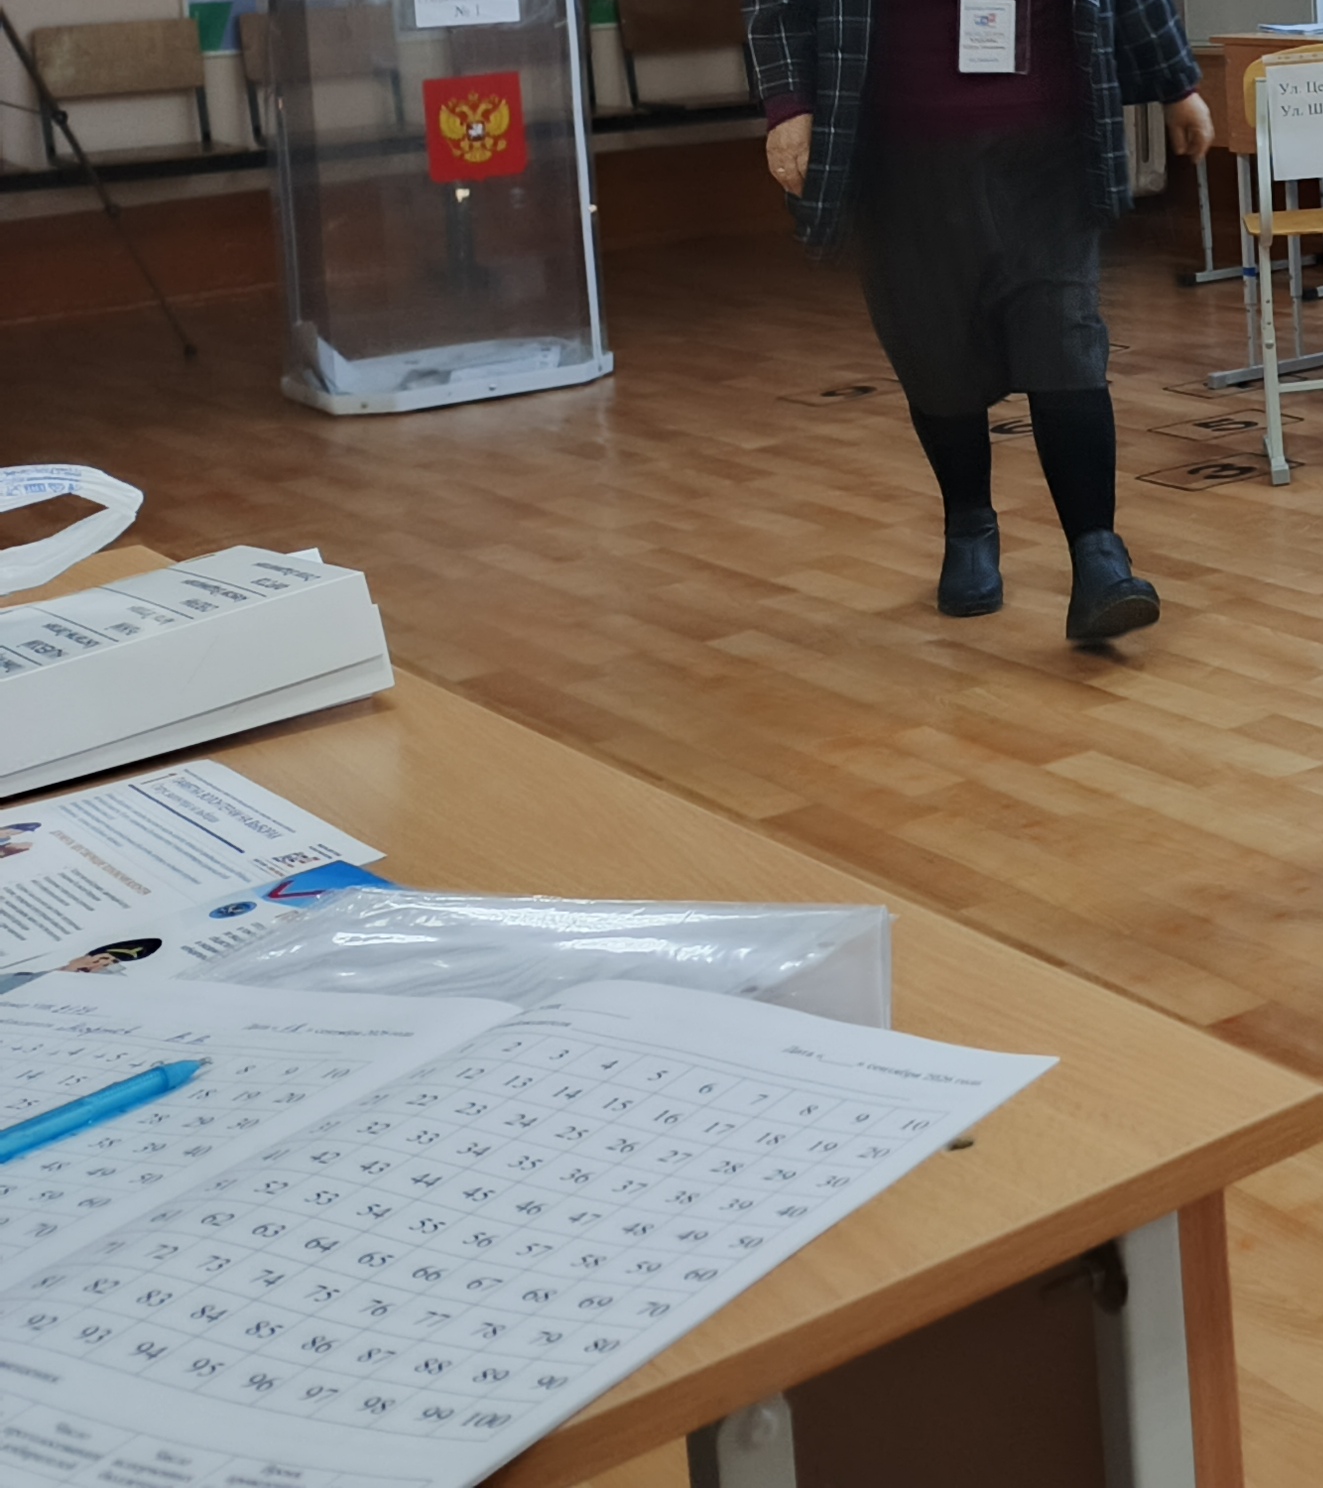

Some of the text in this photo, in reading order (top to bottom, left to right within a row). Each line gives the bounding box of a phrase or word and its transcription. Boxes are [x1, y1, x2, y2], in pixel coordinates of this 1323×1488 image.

[1279, 83, 1302, 95] Ул.
[1280, 105, 1303, 117] Ул.
[1187, 463, 1257, 479] 3
[455, 1067, 486, 1080] 12
[503, 1074, 534, 1089] 13
[552, 1085, 584, 1100] 14
[602, 1097, 634, 1112] 15
[653, 1109, 682, 1125] 16
[703, 1121, 736, 1135] 17
[755, 1131, 787, 1146] 18
[501, 1041, 523, 1053] 2
[548, 1048, 570, 1061] 3
[600, 1059, 619, 1071] 4
[646, 1069, 669, 1082] 5
[698, 1083, 715, 1094] 6
[750, 1093, 770, 1106] 7
[798, 1104, 819, 1116] 8
[356, 1121, 391, 1136] 32
[405, 1129, 441, 1145] 33
[455, 1141, 492, 1158] 34
[507, 1155, 544, 1171] 35
[559, 1167, 593, 1184] 36
[611, 1179, 649, 1195] 37
[665, 1190, 701, 1205] 38
[405, 1093, 439, 1107] 22
[454, 1101, 488, 1116] 23
[503, 1113, 539, 1129] 24
[554, 1125, 590, 1141] 25
[605, 1138, 639, 1154] 26
[656, 1149, 694, 1164] 27
[709, 1160, 745, 1175] 28
[253, 1180, 289, 1196] 52
[304, 1190, 340, 1206] 53
[356, 1203, 393, 1220] 54
[408, 1217, 447, 1235] 55
[462, 1231, 496, 1248] 56
[515, 1242, 554, 1258] 57
[570, 1253, 607, 1269] 58
[309, 1150, 341, 1165] 42
[359, 1160, 391, 1175] 43
[410, 1172, 443, 1189] 44
[462, 1186, 496, 1202] 45
[515, 1200, 545, 1216] 46
[568, 1211, 603, 1225] 47
[622, 1222, 655, 1237] 48
[149, 1243, 180, 1261] 72
[198, 1254, 232, 1272] 73
[253, 1268, 286, 1288] 74
[308, 1284, 341, 1303] 75
[362, 1298, 393, 1317] 76
[415, 1310, 453, 1327] 77
[473, 1321, 507, 1339] 78
[200, 1212, 236, 1227] 62
[251, 1222, 287, 1238] 63
[304, 1236, 340, 1254] 64
[357, 1251, 395, 1268] 65
[411, 1265, 445, 1282] 66
[465, 1276, 504, 1290] 67
[521, 1288, 558, 1303] 68
[24, 1313, 59, 1332] 92
[77, 1325, 113, 1345] 93
[132, 1341, 169, 1361] 94
[187, 1358, 226, 1377] 95
[243, 1372, 278, 1392] 96
[302, 1385, 340, 1402] 97
[361, 1396, 396, 1415] 98
[82, 1278, 121, 1295] 82
[135, 1289, 174, 1307] 83
[189, 1304, 228, 1324] 84
[244, 1321, 284, 1339] 85
[300, 1335, 336, 1354] 86
[356, 1347, 397, 1364] 87
[414, 1358, 452, 1375] 88
